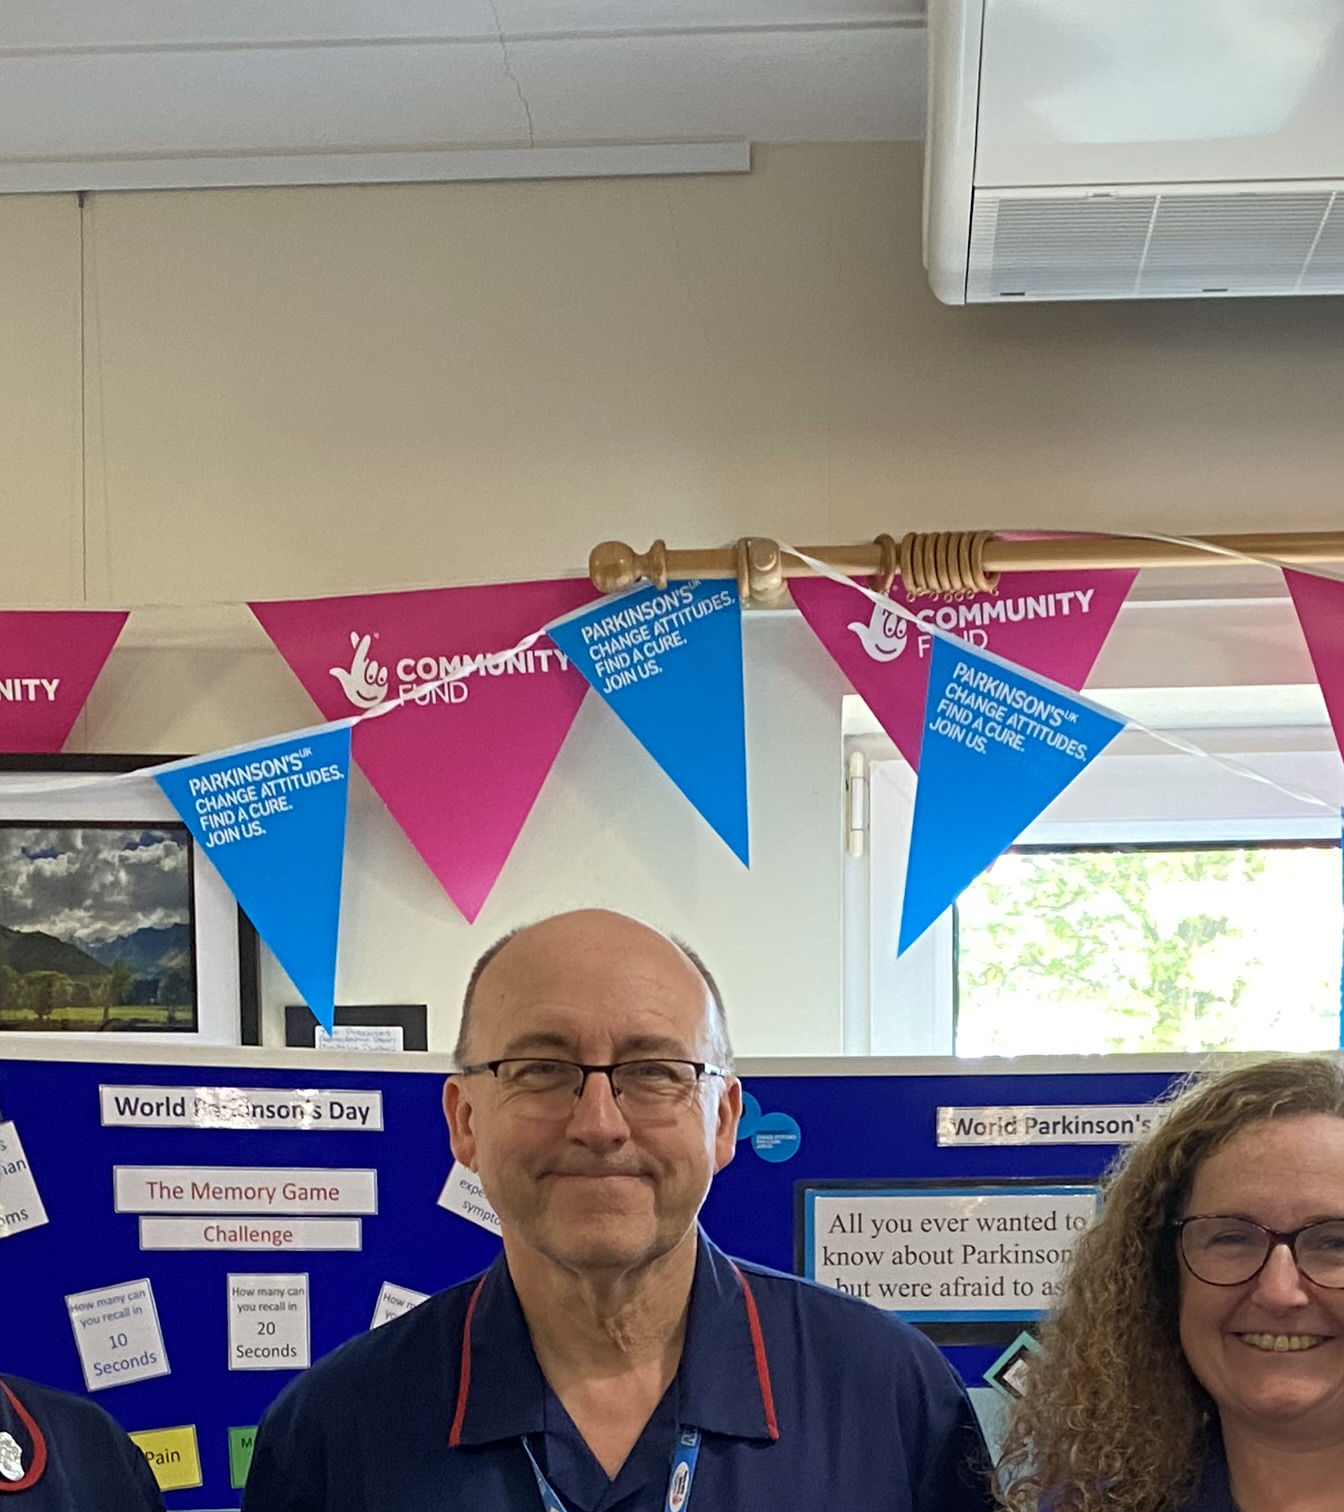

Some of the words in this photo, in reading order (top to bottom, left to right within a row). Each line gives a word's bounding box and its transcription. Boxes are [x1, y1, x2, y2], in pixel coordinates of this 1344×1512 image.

[581, 585, 693, 644] PARKINSON'S
[916, 588, 1095, 632] COMMUNITY
[589, 626, 651, 661] CHANGE
[654, 591, 735, 635] ATTITUDES.
[396, 648, 569, 682] COMMUNITY
[595, 652, 630, 678] FIND
[644, 631, 687, 658] CURE.
[603, 670, 637, 693] JOIN
[638, 660, 662, 679] US.
[398, 681, 469, 706] FUND
[953, 662, 1064, 727] PARKINSON'S
[929, 717, 966, 743] JOIN
[965, 732, 988, 754] US.
[937, 699, 972, 725] FIND
[985, 722, 1026, 752] CURE.
[945, 683, 1007, 722] CHANGE
[1007, 713, 1088, 761] ATTITUDES.
[189, 753, 303, 796] PARKINSON'S
[195, 786, 258, 814] CHANGE
[261, 764, 344, 798] ATTITUDES.
[200, 810, 235, 831] FIND
[249, 796, 293, 818] CURE.
[206, 826, 240, 847] JOIN
[242, 821, 266, 839] US.
[115, 1097, 186, 1118] World
[329, 1101, 371, 1125] Day
[954, 1116, 1019, 1138] World
[146, 1181, 184, 1201] The
[190, 1181, 277, 1205] Memory
[282, 1182, 340, 1202] Game
[203, 1224, 293, 1247] Challenge
[828, 1213, 864, 1234] All
[871, 1217, 913, 1239] you
[920, 1217, 969, 1233] ever
[976, 1211, 1059, 1232] wanted
[1064, 1211, 1086, 1231] to
[822, 1245, 882, 1267] know
[891, 1245, 955, 1266] about
[232, 1287, 255, 1297] How
[257, 1287, 286, 1299] many
[287, 1287, 305, 1296] can
[878, 1282, 933, 1298] were
[939, 1276, 1006, 1297] afraid
[1012, 1277, 1034, 1297] to
[80, 1316, 100, 1329] you
[105, 1308, 131, 1322] recall
[237, 1303, 256, 1314] you
[258, 1301, 286, 1311] recall
[288, 1302, 298, 1311] in
[108, 1332, 129, 1350] 10
[257, 1321, 276, 1336] 20
[93, 1351, 158, 1377] Seconds
[236, 1344, 298, 1359] Seconds
[143, 1447, 181, 1467] Pain
